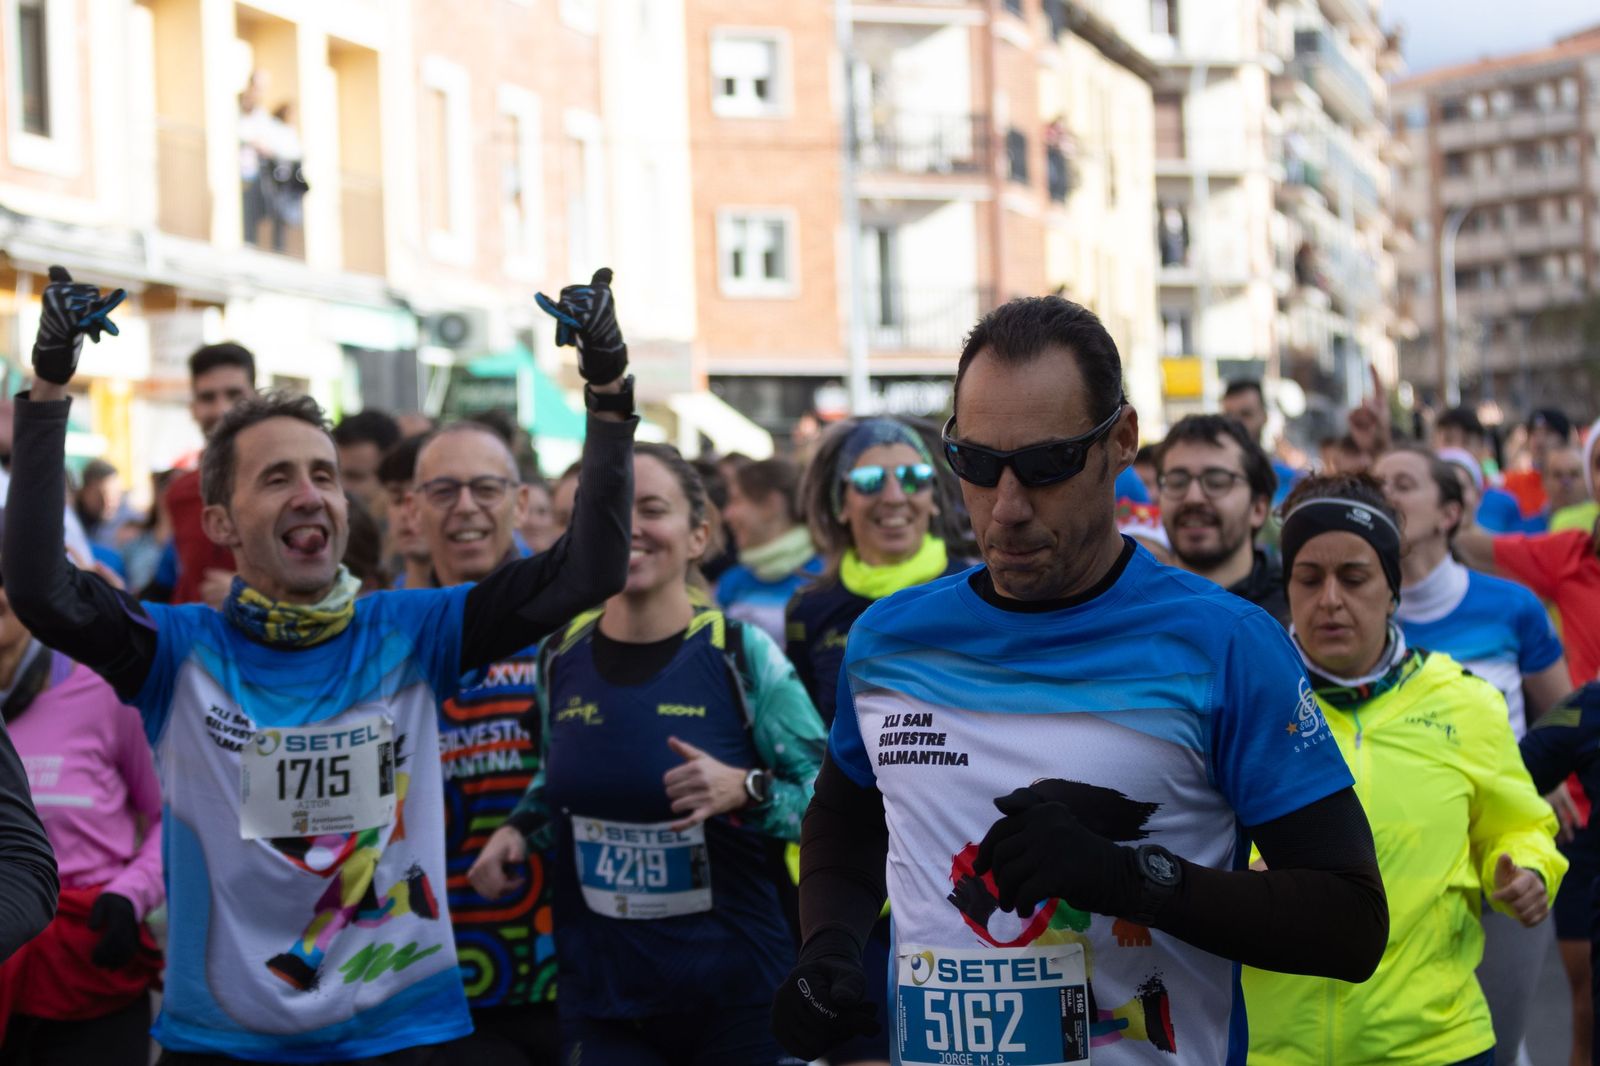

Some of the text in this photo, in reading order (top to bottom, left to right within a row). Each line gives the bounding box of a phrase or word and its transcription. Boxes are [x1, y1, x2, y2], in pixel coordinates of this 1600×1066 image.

[882, 713, 933, 729] XLI SAN
[285, 725, 380, 752] SETEL
[878, 732, 947, 748] SILVESTRE
[878, 750, 969, 767] SALMANTINA
[276, 755, 350, 800] 1715
[605, 826, 691, 845] SETEL
[595, 844, 668, 887] 4219
[938, 957, 1063, 983] SETEL
[1076, 993, 1085, 1014] 5162
[924, 990, 1027, 1053] 5162
[938, 1052, 973, 1065] JORGE
